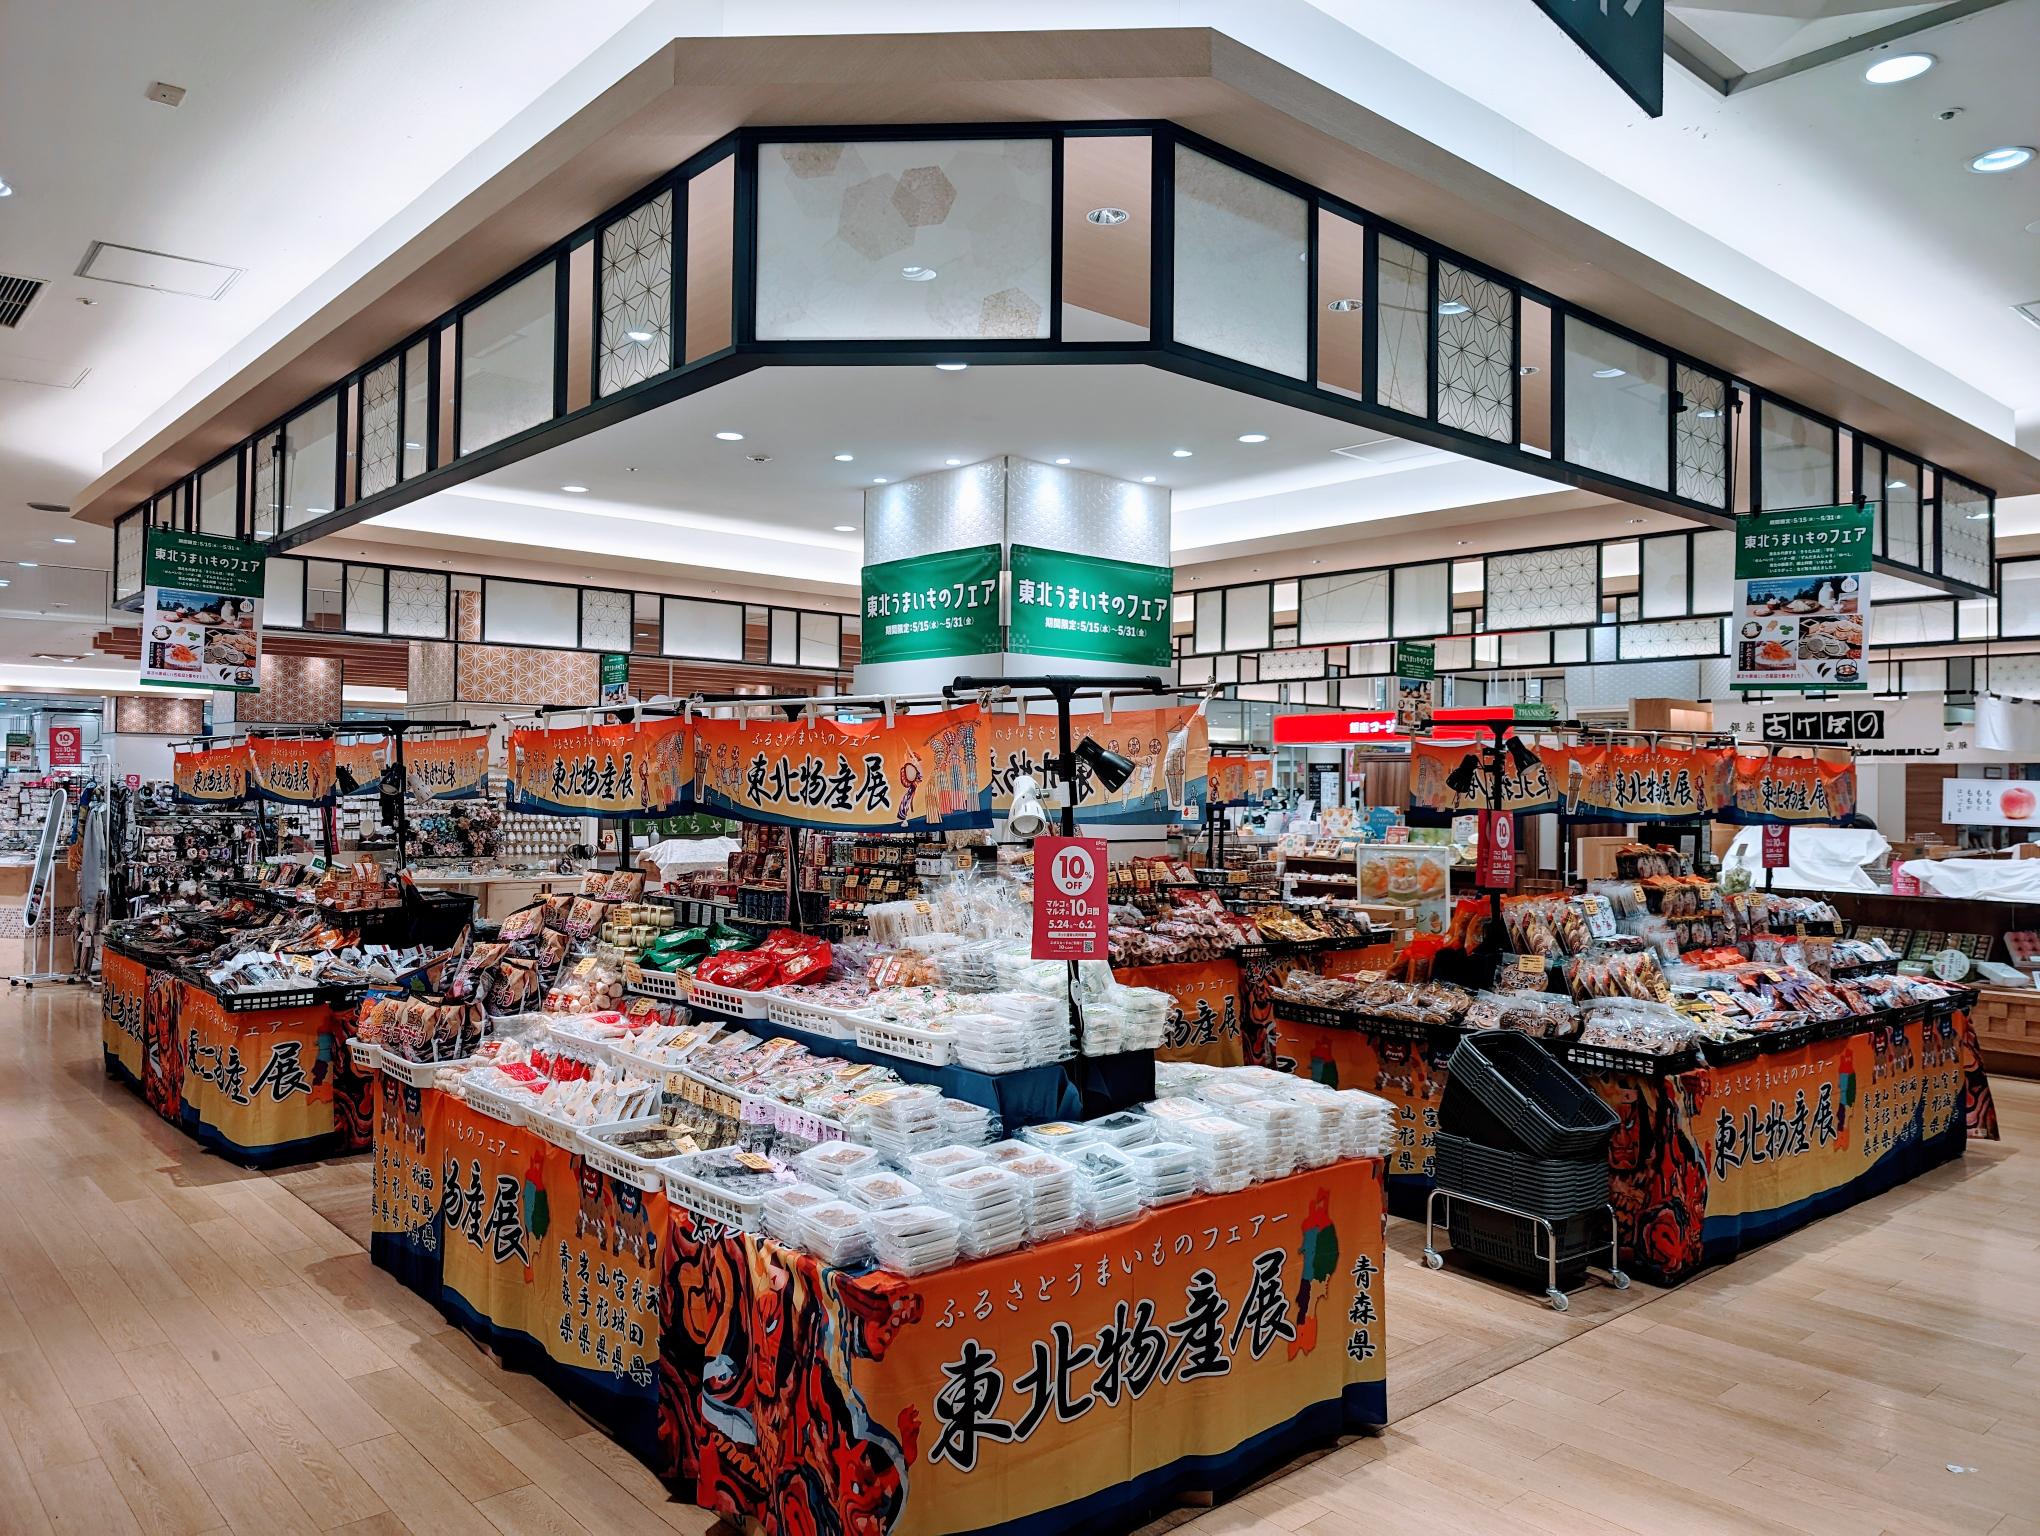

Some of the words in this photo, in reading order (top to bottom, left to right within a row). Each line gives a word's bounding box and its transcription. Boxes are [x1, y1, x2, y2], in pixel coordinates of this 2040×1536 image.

[154, 547, 261, 573] 東北うまいものフェア
[1744, 527, 1867, 549] 東北うまいものフェア
[867, 579, 996, 618] 東北うまいものフェア
[1018, 578, 1168, 622] 東北うまいものフェア
[1518, 709, 1545, 717] THANKS!
[1763, 711, 1884, 740] あけぼの
[551, 752, 634, 801] 東北物産展
[745, 750, 892, 814] 東北物産展
[1614, 768, 1695, 809] 東北物産展
[1760, 777, 1830, 812] 東北物産展
[1059, 855, 1092, 879] 10%
[1065, 881, 1082, 889] OFF
[1713, 1060, 1833, 1099] ふるさとうまいものフェアー
[447, 1117, 520, 1158] いものフェアー
[1398, 1104, 1416, 1171] 山形県
[1420, 1106, 1439, 1178] 宮城県
[1713, 1081, 1838, 1182] 東北物産展
[420, 1167, 437, 1253] 福島県
[935, 1212, 1288, 1329] ふるさとうまいものフェアー
[577, 1249, 592, 1355] 岩手県
[595, 1262, 610, 1367] 山形県
[611, 1266, 629, 1380] 宮城県
[1347, 1253, 1379, 1362] 青森県
[628, 1276, 653, 1388] 秋田県
[928, 1247, 1297, 1473] 東北物産展
